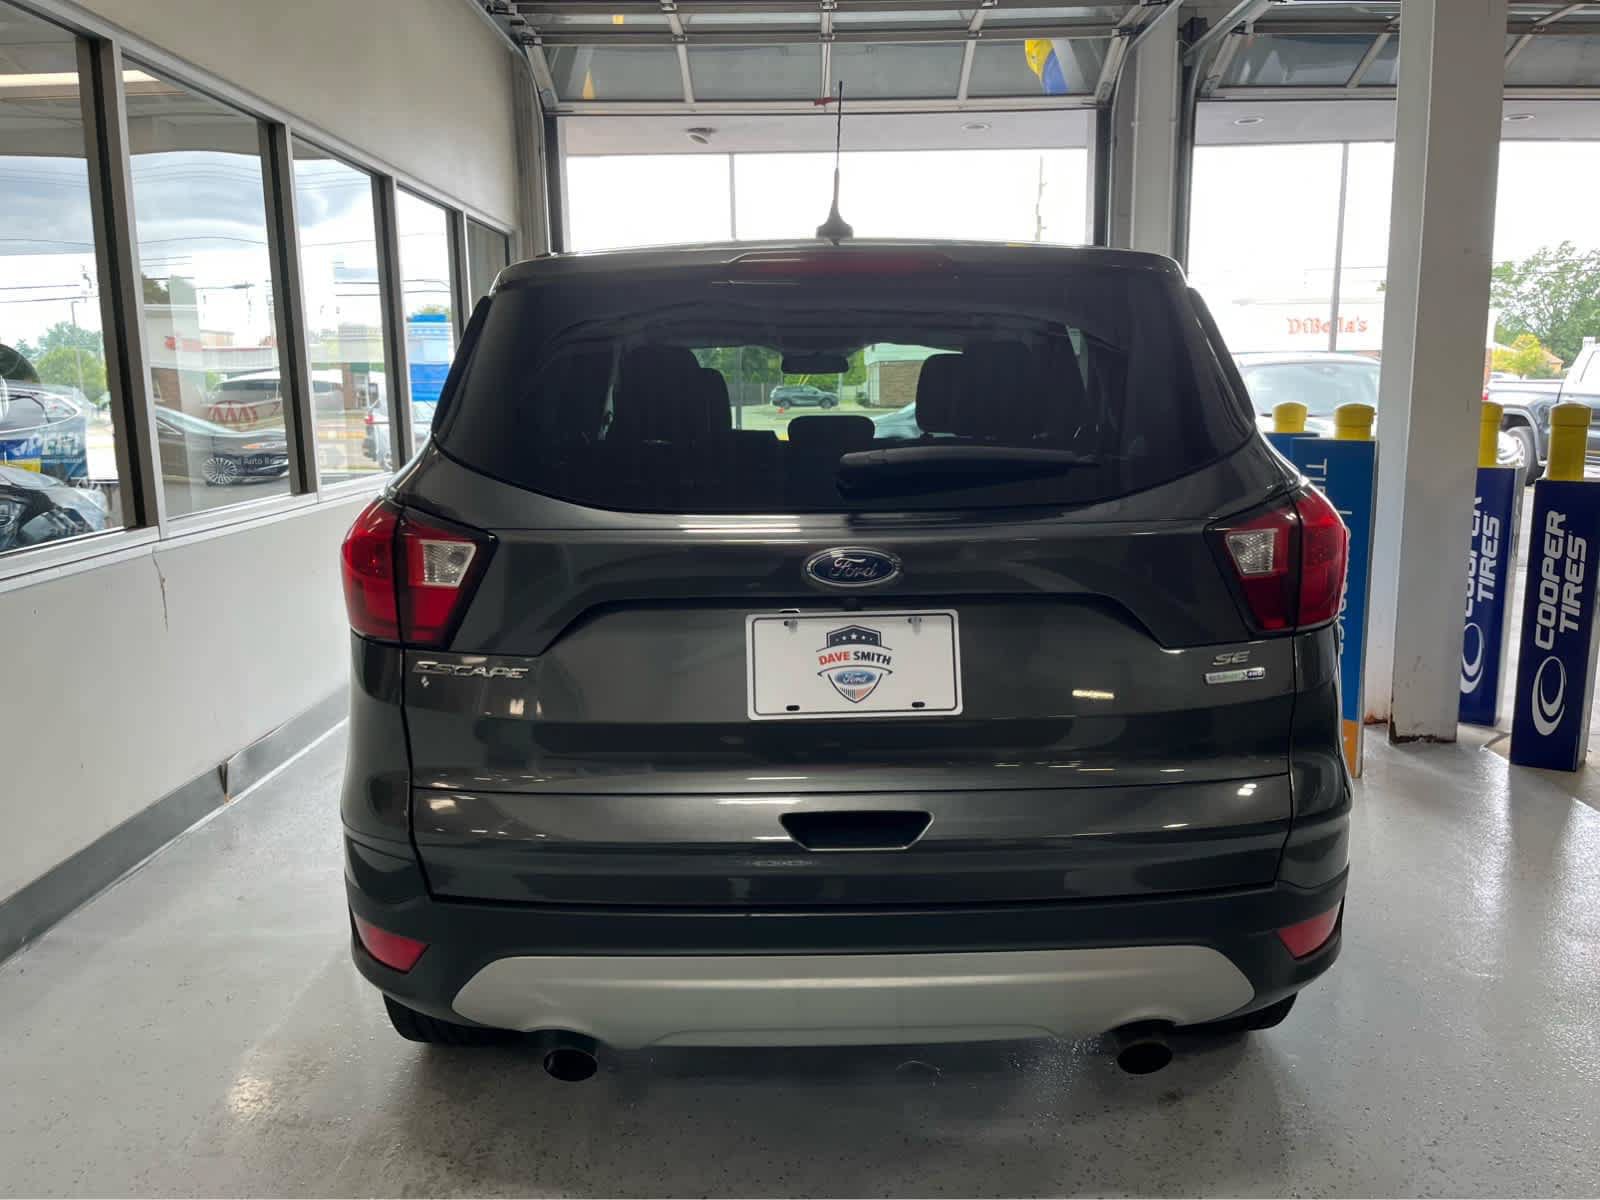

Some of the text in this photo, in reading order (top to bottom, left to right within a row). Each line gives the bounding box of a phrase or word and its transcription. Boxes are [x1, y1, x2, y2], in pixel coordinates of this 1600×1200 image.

[1286, 314, 1368, 335] DiBela's
[830, 556, 878, 577] Ford
[1477, 512, 1500, 602] TIRES
[1535, 510, 1566, 651] COOPER
[1559, 534, 1587, 633] TIRES
[819, 650, 892, 665] DAVE SMITH
[1212, 650, 1250, 665] SE
[413, 661, 529, 678] ESCAPE
